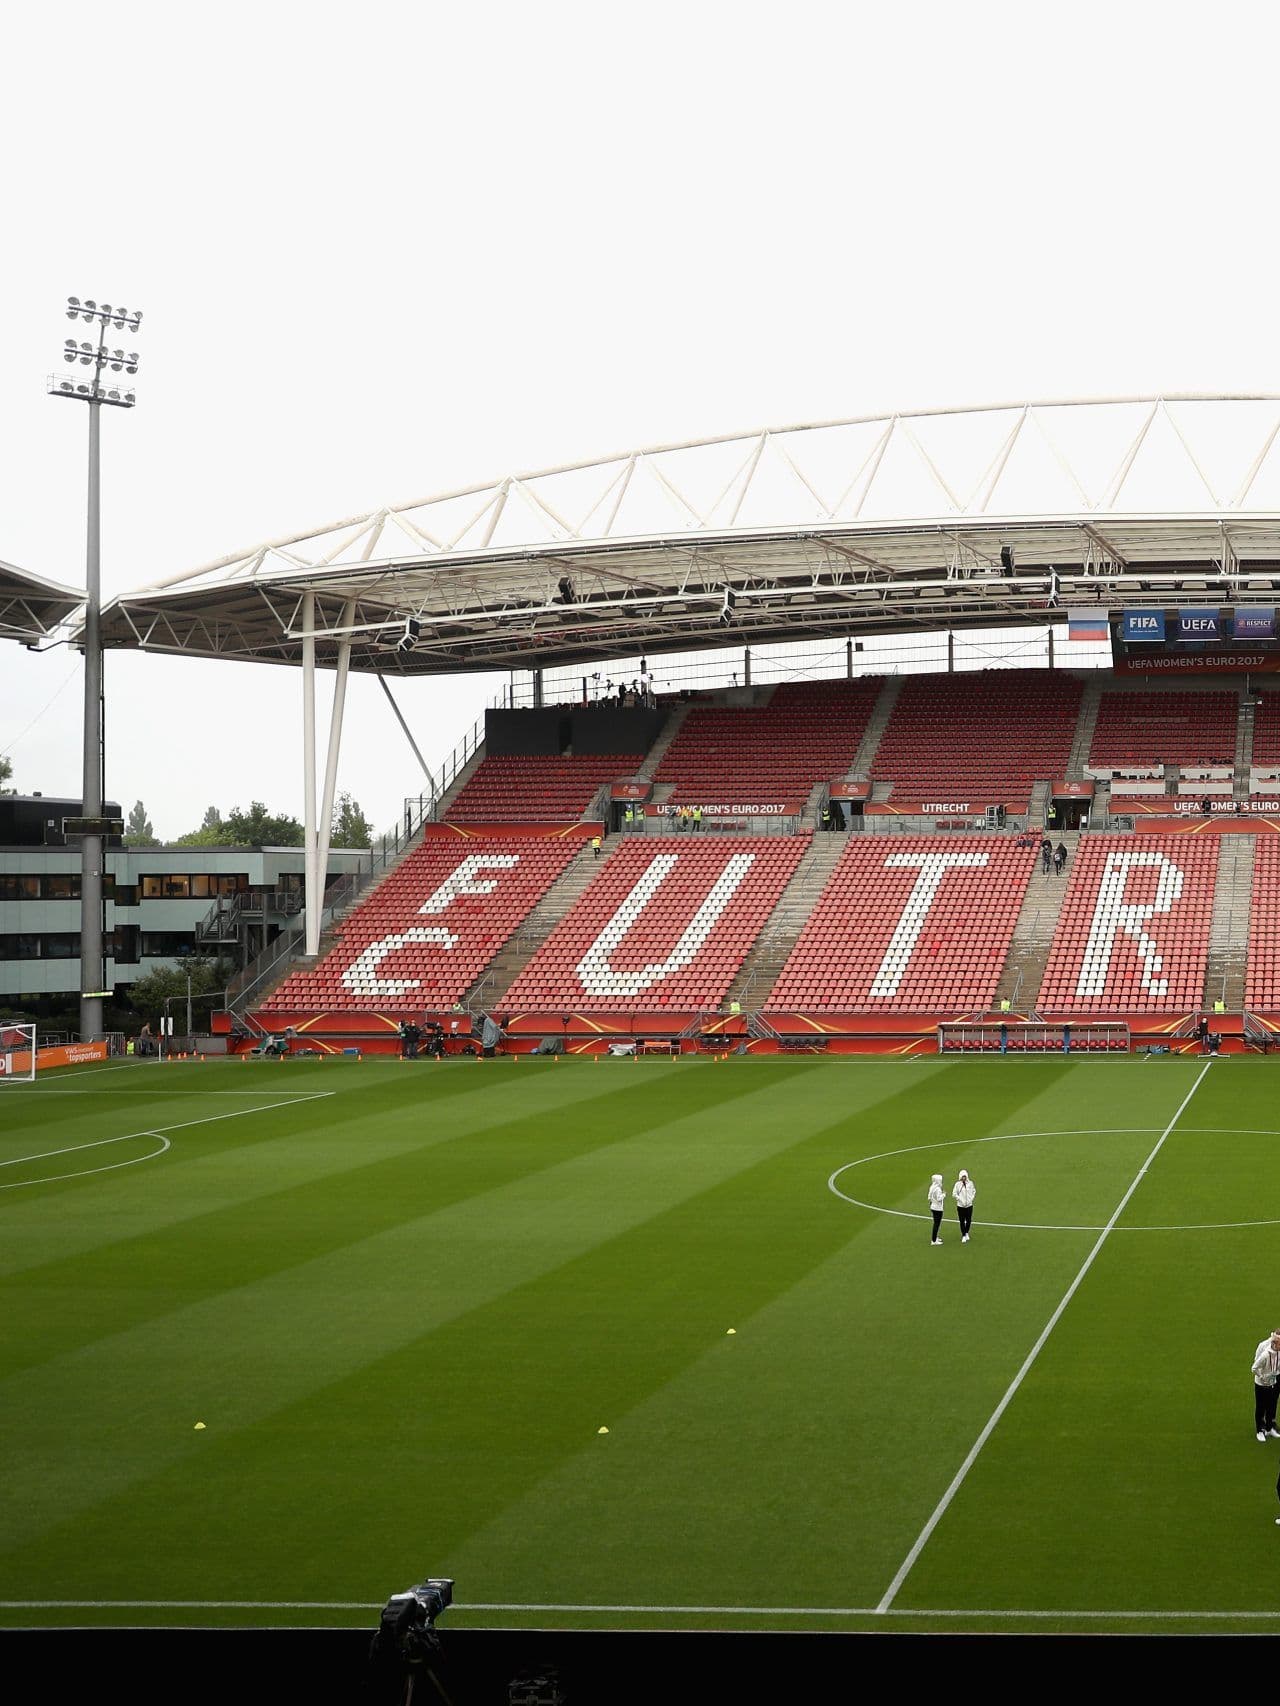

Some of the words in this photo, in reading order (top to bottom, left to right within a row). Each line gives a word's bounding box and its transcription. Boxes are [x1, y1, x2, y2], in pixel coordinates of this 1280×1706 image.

[1129, 617, 1158, 628] FIFA
[1181, 619, 1216, 629] UEFA
[1128, 660, 1153, 669] UEFA
[1153, 657, 1204, 668] WOMEN'S
[1206, 657, 1236, 666] EURO
[1237, 656, 1265, 666] 2017
[732, 804, 759, 814] EURO
[760, 804, 786, 813] 2017
[922, 803, 970, 813] UTRECHT
[1174, 802, 1200, 811] UEFA
[1251, 802, 1279, 811] EURO
